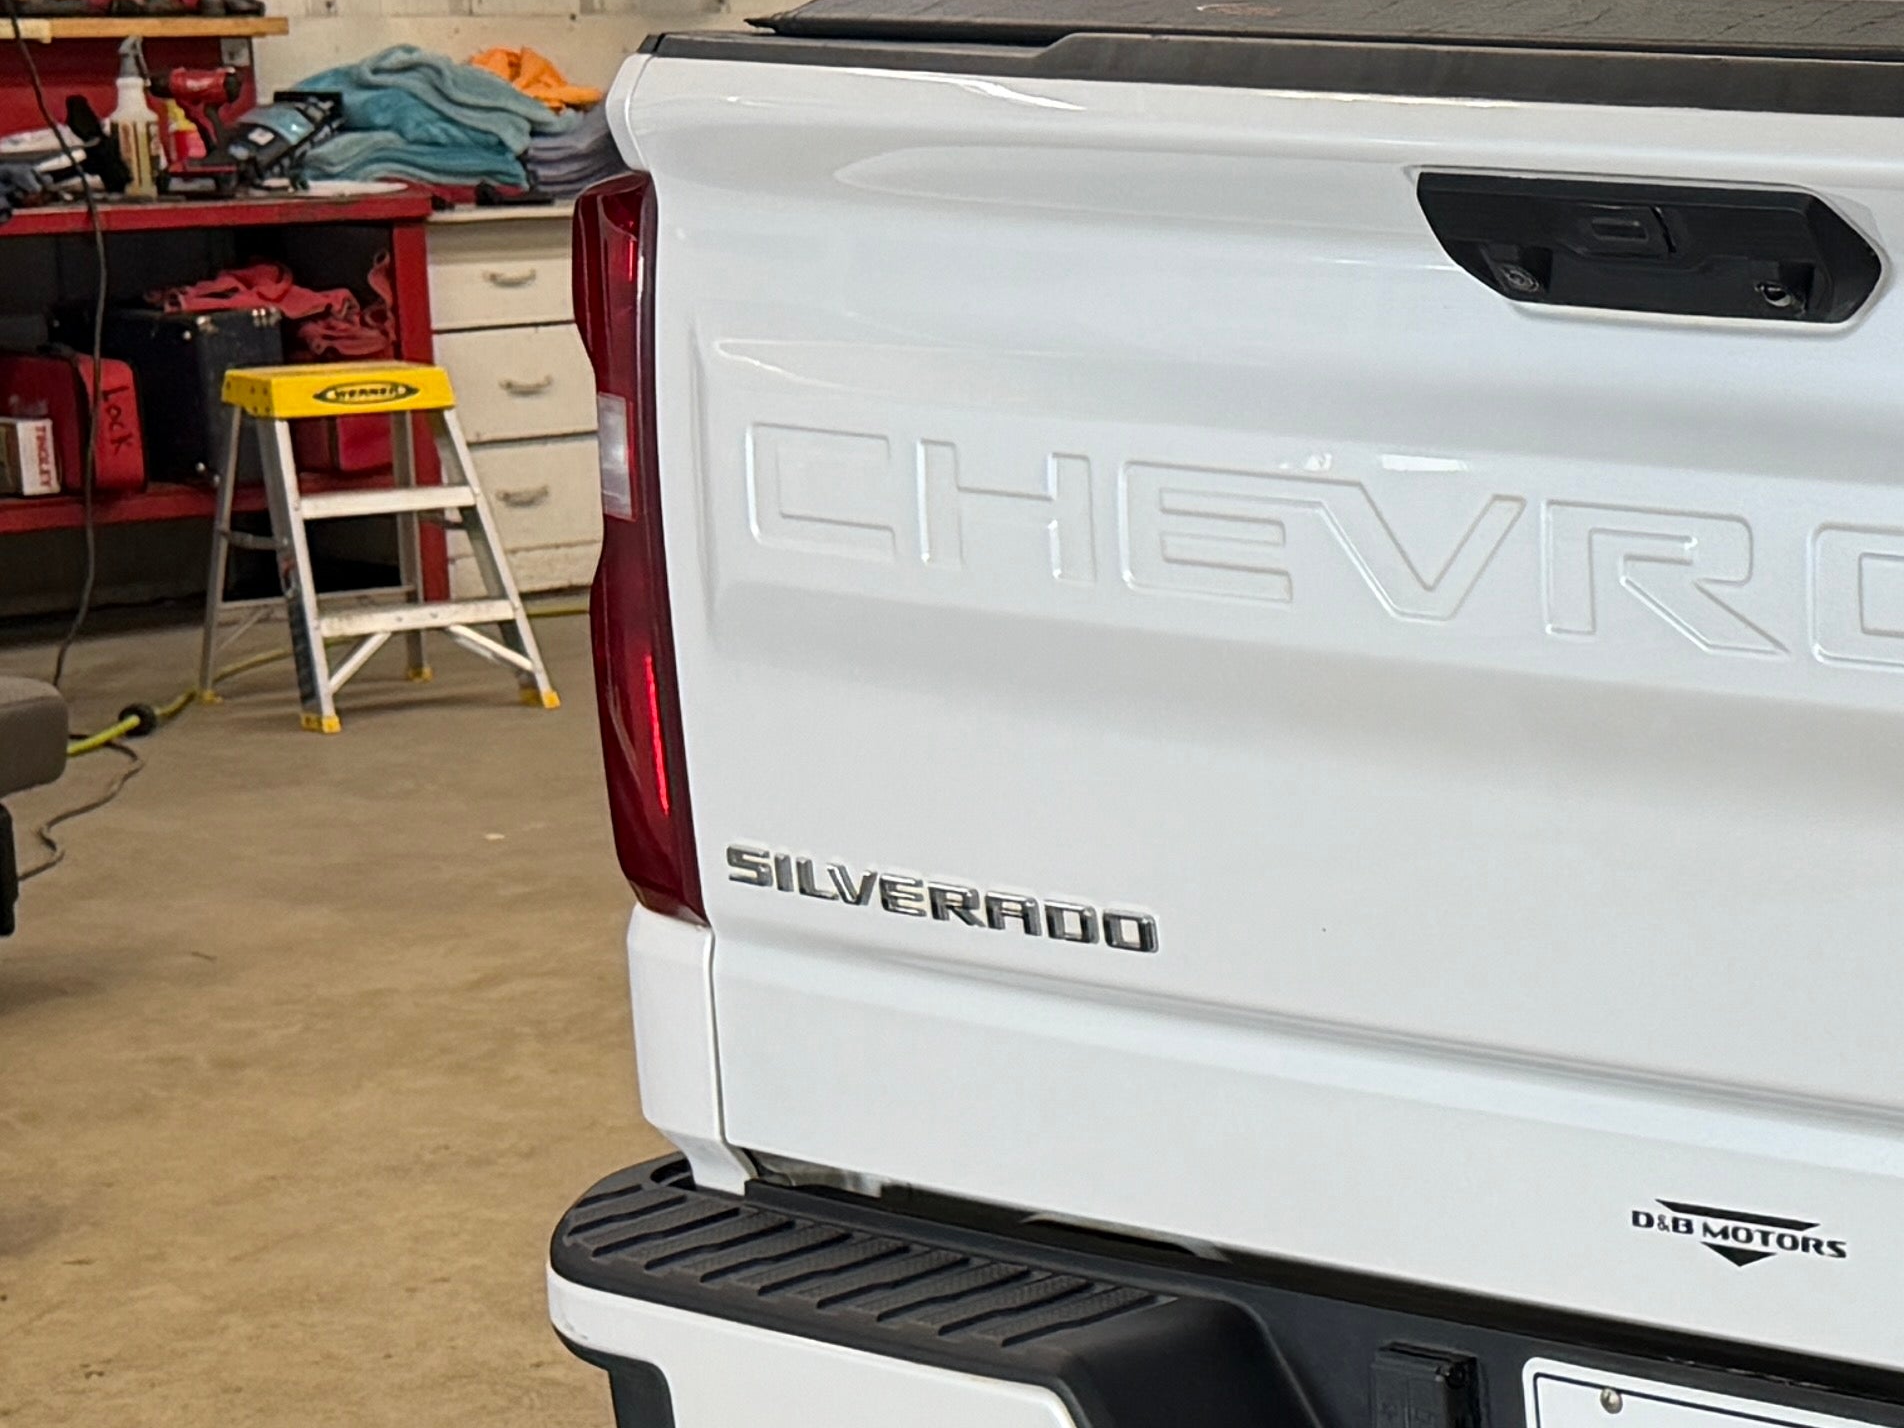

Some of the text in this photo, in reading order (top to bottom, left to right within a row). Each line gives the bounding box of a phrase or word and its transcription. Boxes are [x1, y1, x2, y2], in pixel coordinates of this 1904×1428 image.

[726, 843, 1160, 954] SILVERADO
[1631, 1210, 1848, 1259] D&B MOTORS
